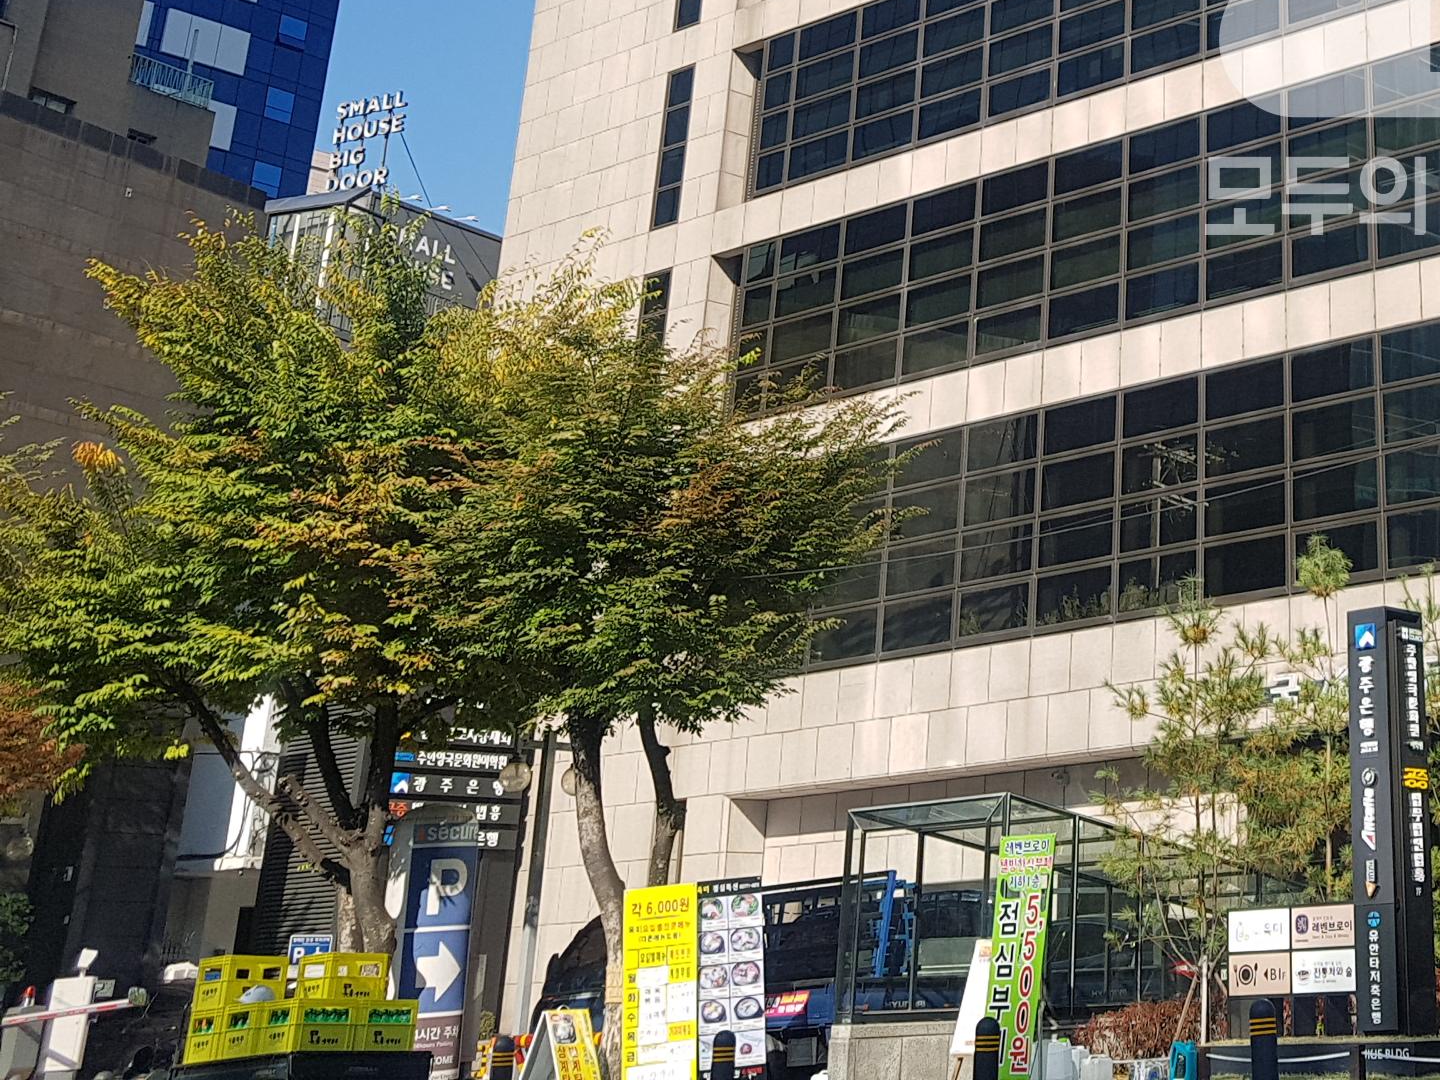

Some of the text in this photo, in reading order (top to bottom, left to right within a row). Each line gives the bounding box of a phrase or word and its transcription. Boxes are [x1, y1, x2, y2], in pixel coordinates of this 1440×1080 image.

[336, 91, 407, 120] SMALL
[332, 114, 406, 145] HOUSE
[328, 146, 365, 169] BIG
[325, 167, 388, 192] DOOR
[1358, 655, 1376, 737] 광주은행
[1005, 839, 1050, 855] 레벤브로이
[426, 858, 468, 916] P
[646, 896, 690, 916] 6,000원
[1311, 919, 1353, 934] 레벤브로이
[988, 901, 1019, 1064] 점심부
[1009, 894, 1042, 1074] 5,500원
[1368, 929, 1382, 1025] 유안타저축은행
